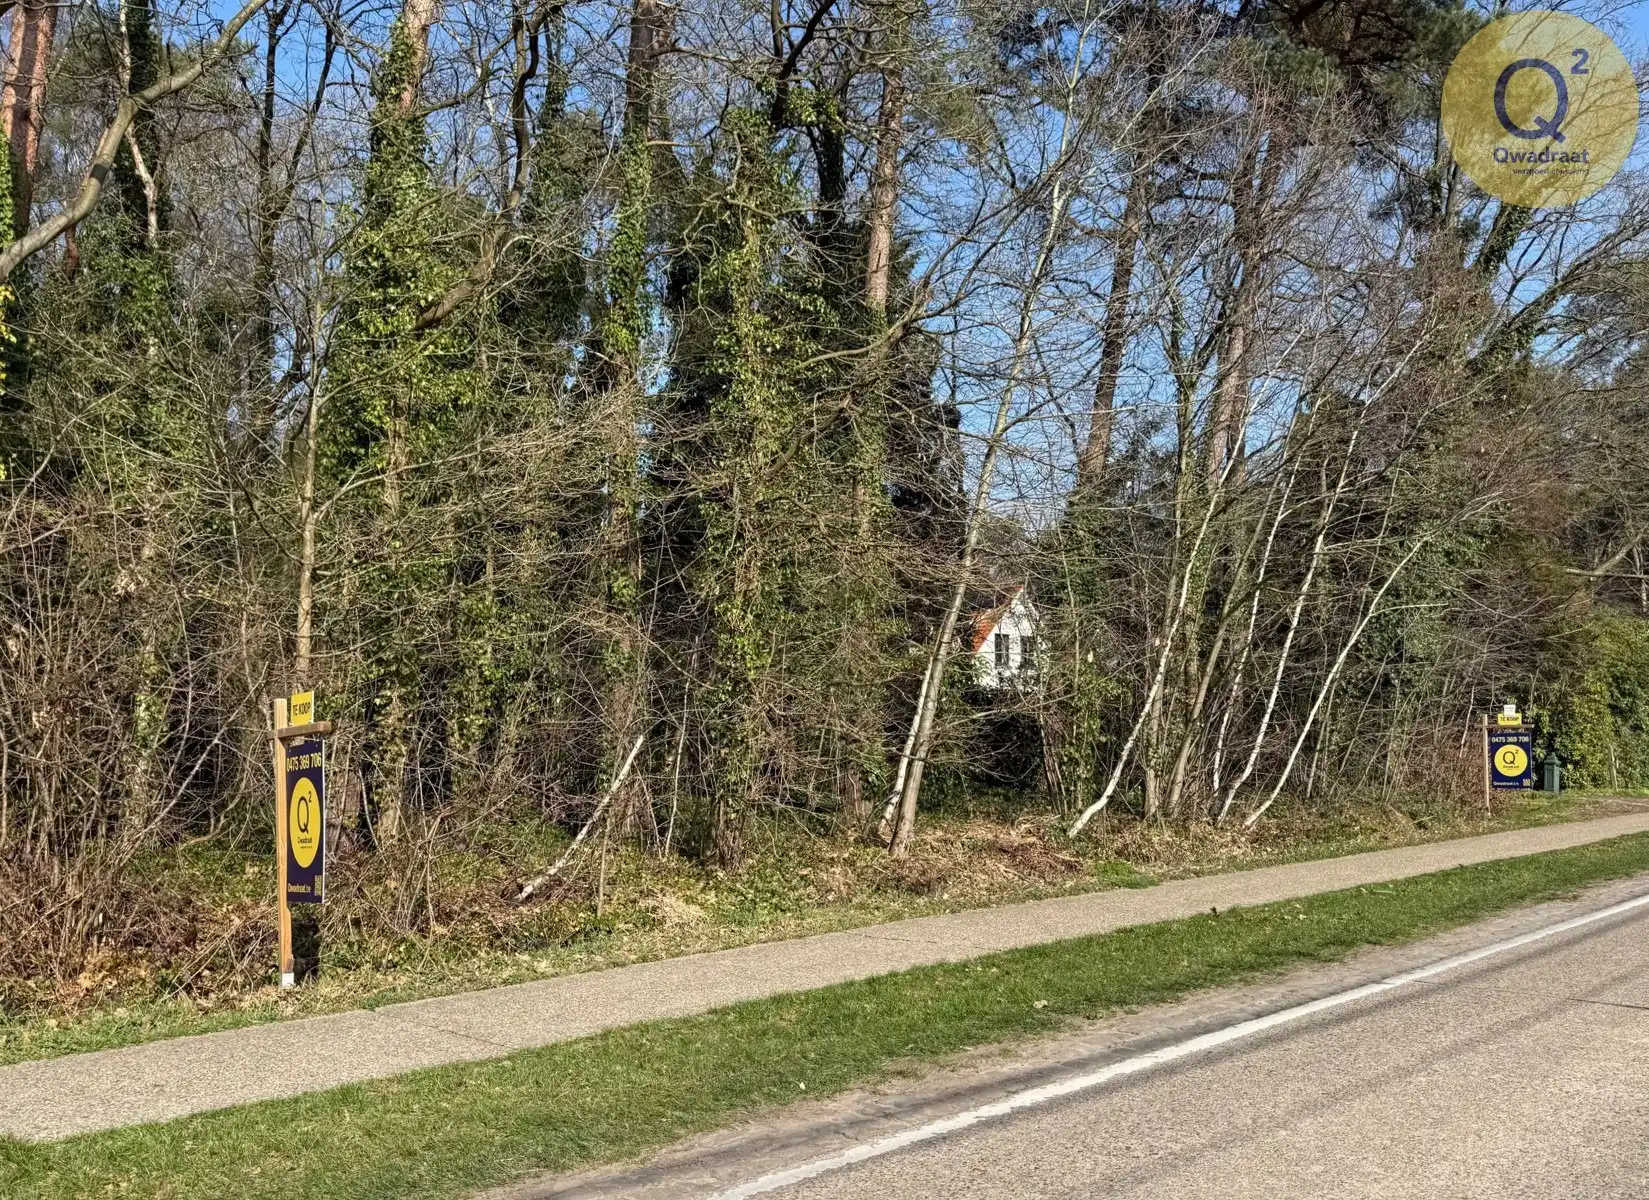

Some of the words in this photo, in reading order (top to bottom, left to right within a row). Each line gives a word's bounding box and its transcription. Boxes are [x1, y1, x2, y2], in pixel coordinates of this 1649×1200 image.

[292, 704, 298, 716] TE
[299, 702, 311, 715] KOOP
[287, 756, 299, 771] 0475
[299, 754, 309, 770] 369
[310, 752, 321, 768] 706
